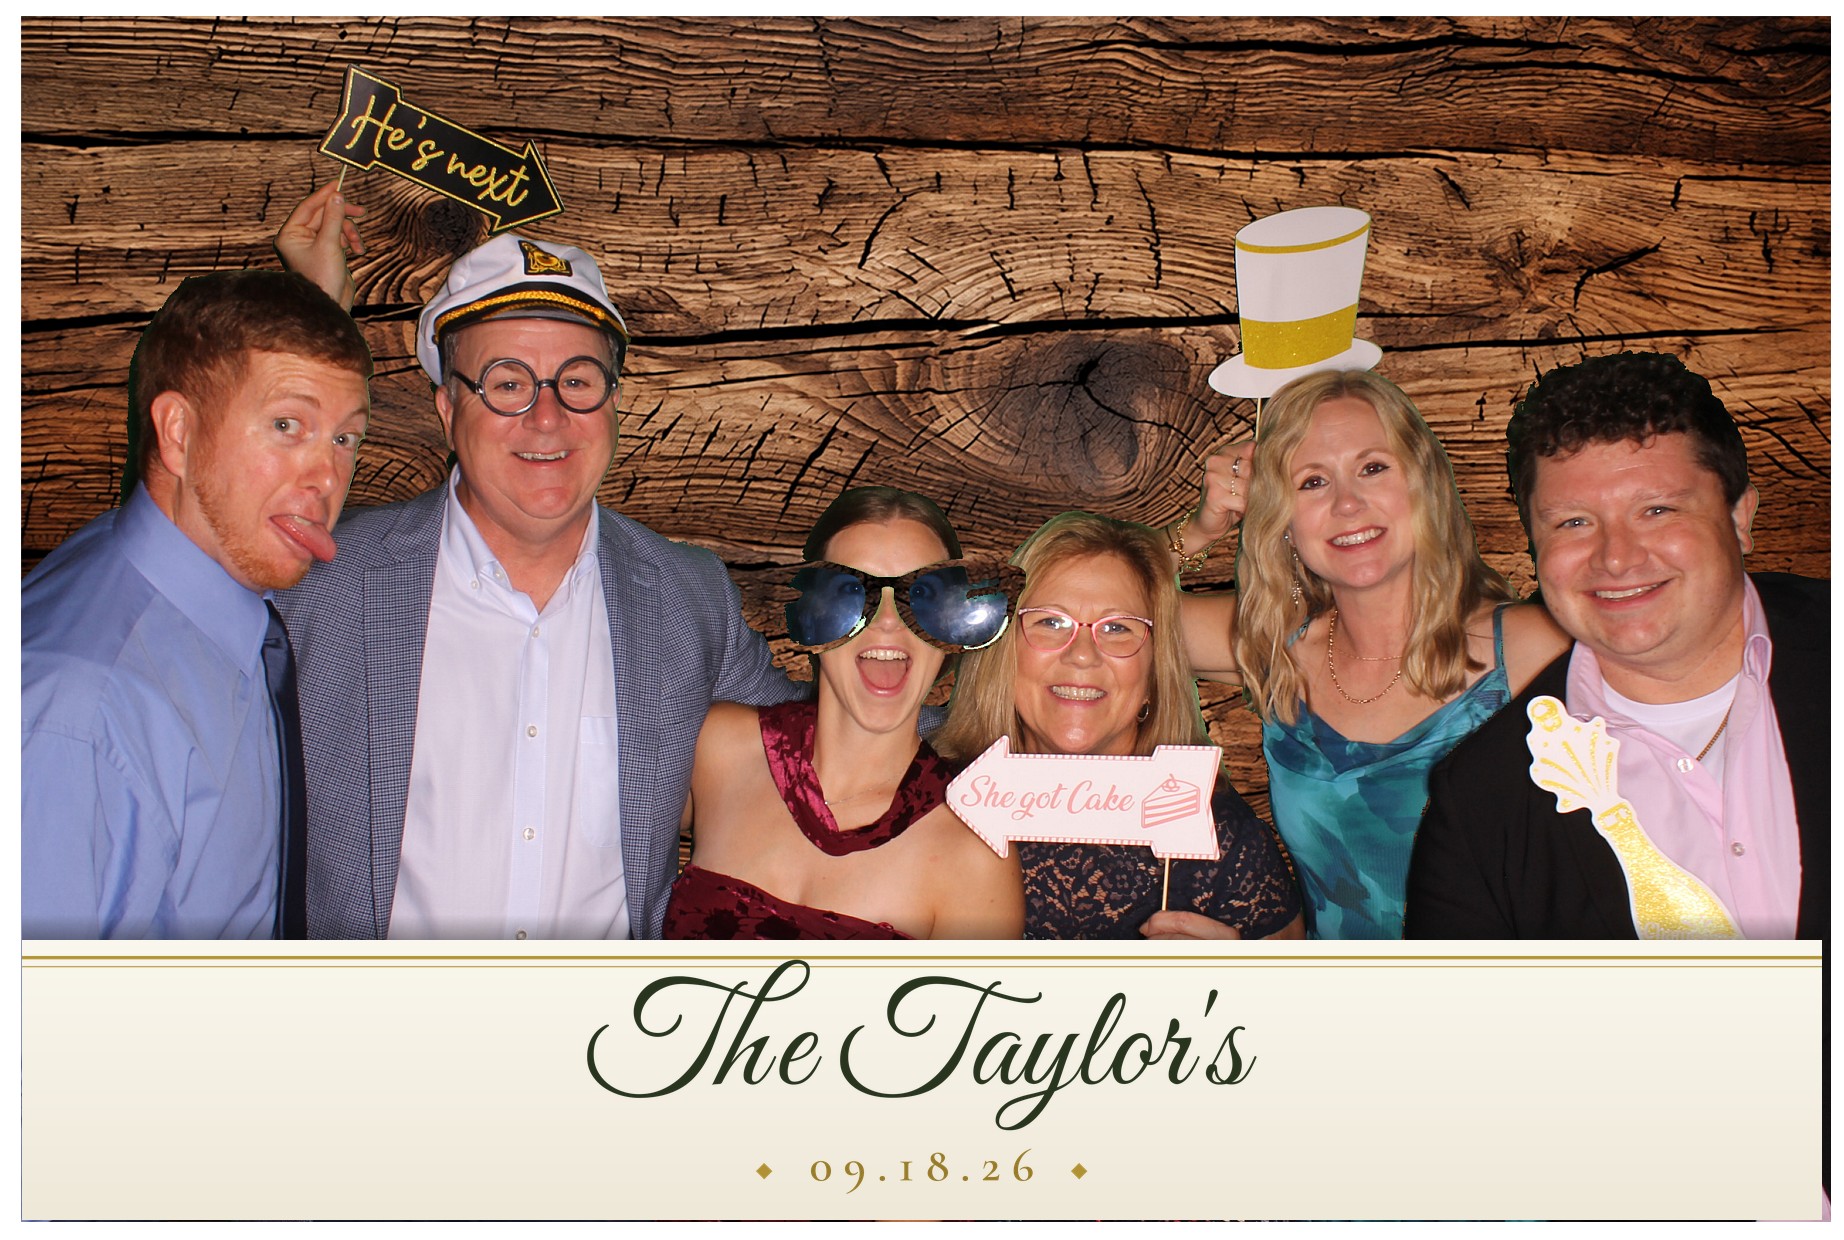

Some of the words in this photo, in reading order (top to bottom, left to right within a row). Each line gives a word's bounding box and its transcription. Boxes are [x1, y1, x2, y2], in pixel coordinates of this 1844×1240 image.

[344, 94, 445, 171] He's
[446, 152, 530, 207] next
[960, 775, 1017, 809] She
[1011, 783, 1063, 820] got
[1066, 780, 1136, 815] Cake
